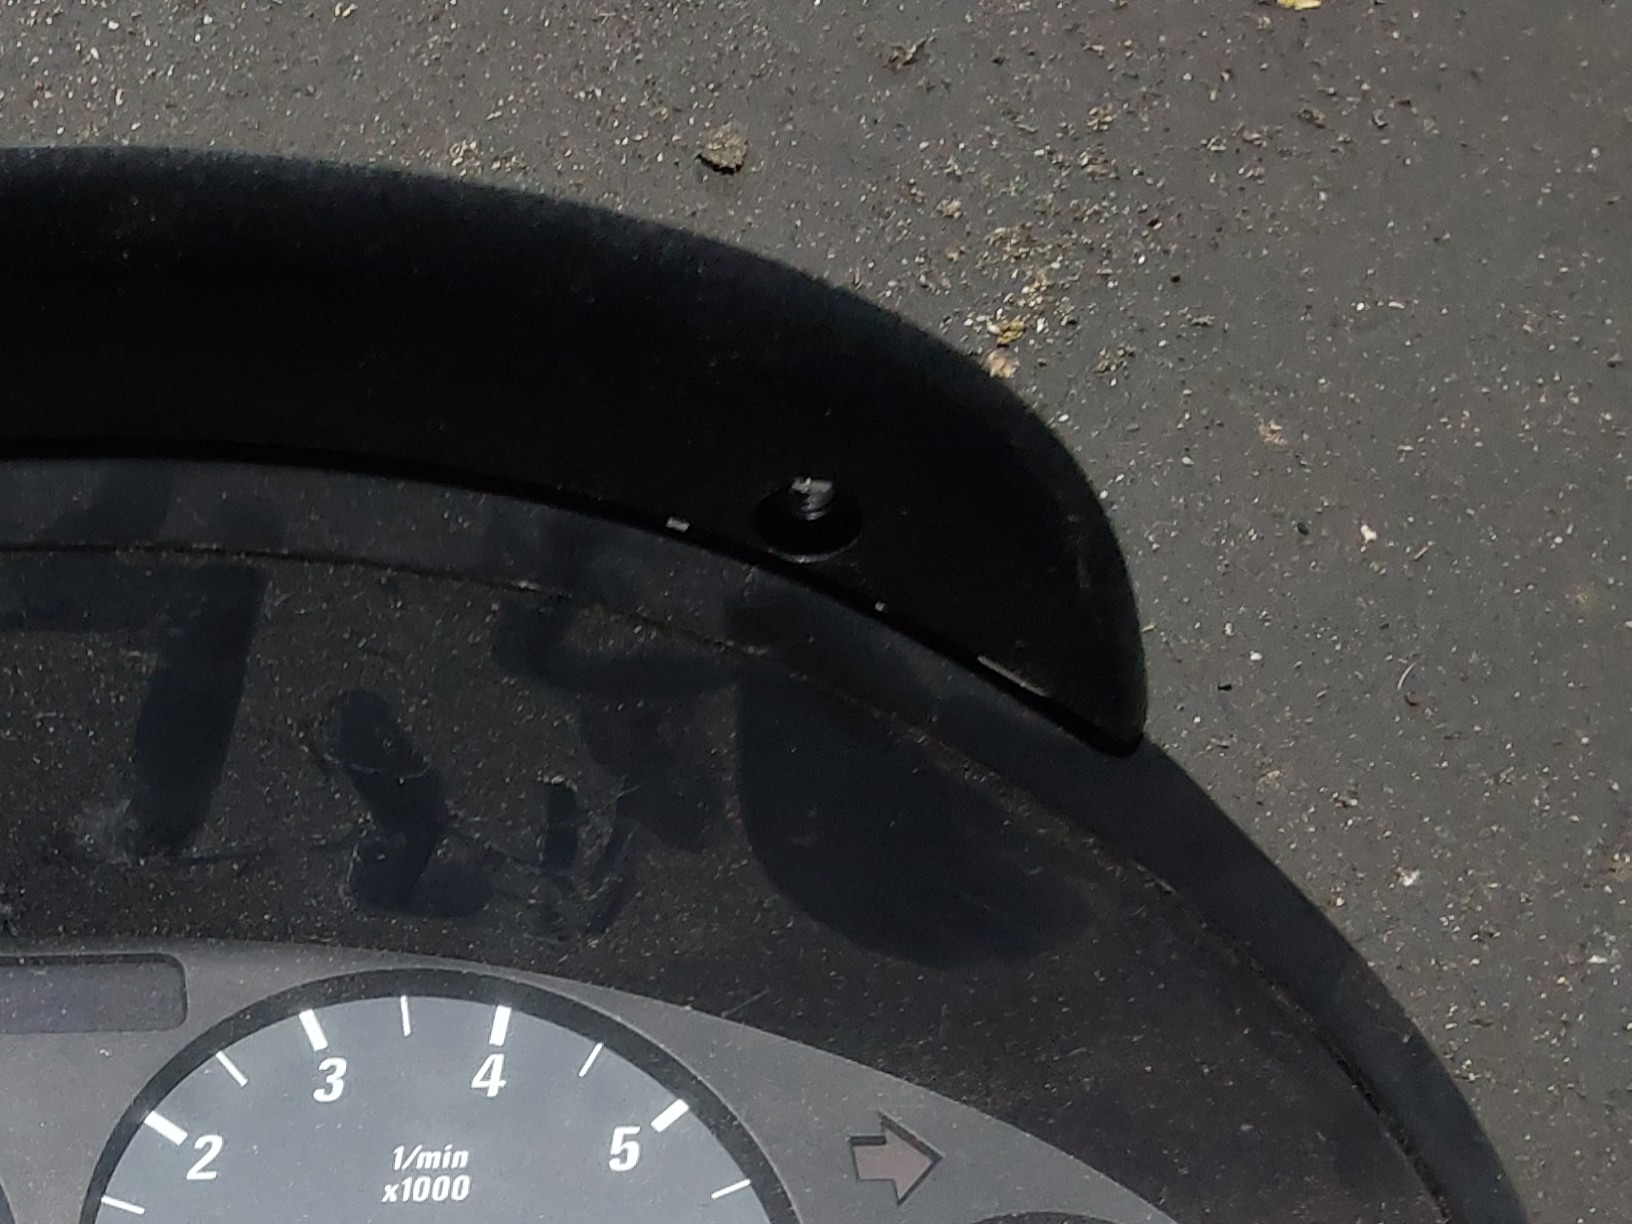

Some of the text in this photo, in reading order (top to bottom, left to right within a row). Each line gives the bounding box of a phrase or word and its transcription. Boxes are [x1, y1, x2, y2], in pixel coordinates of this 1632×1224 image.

[313, 1058, 346, 1102] 3
[472, 1054, 506, 1097] 4
[186, 1135, 223, 1180] 2
[391, 1145, 469, 1170] 1/min
[608, 1126, 641, 1171] 5
[381, 1175, 470, 1203] x1000
